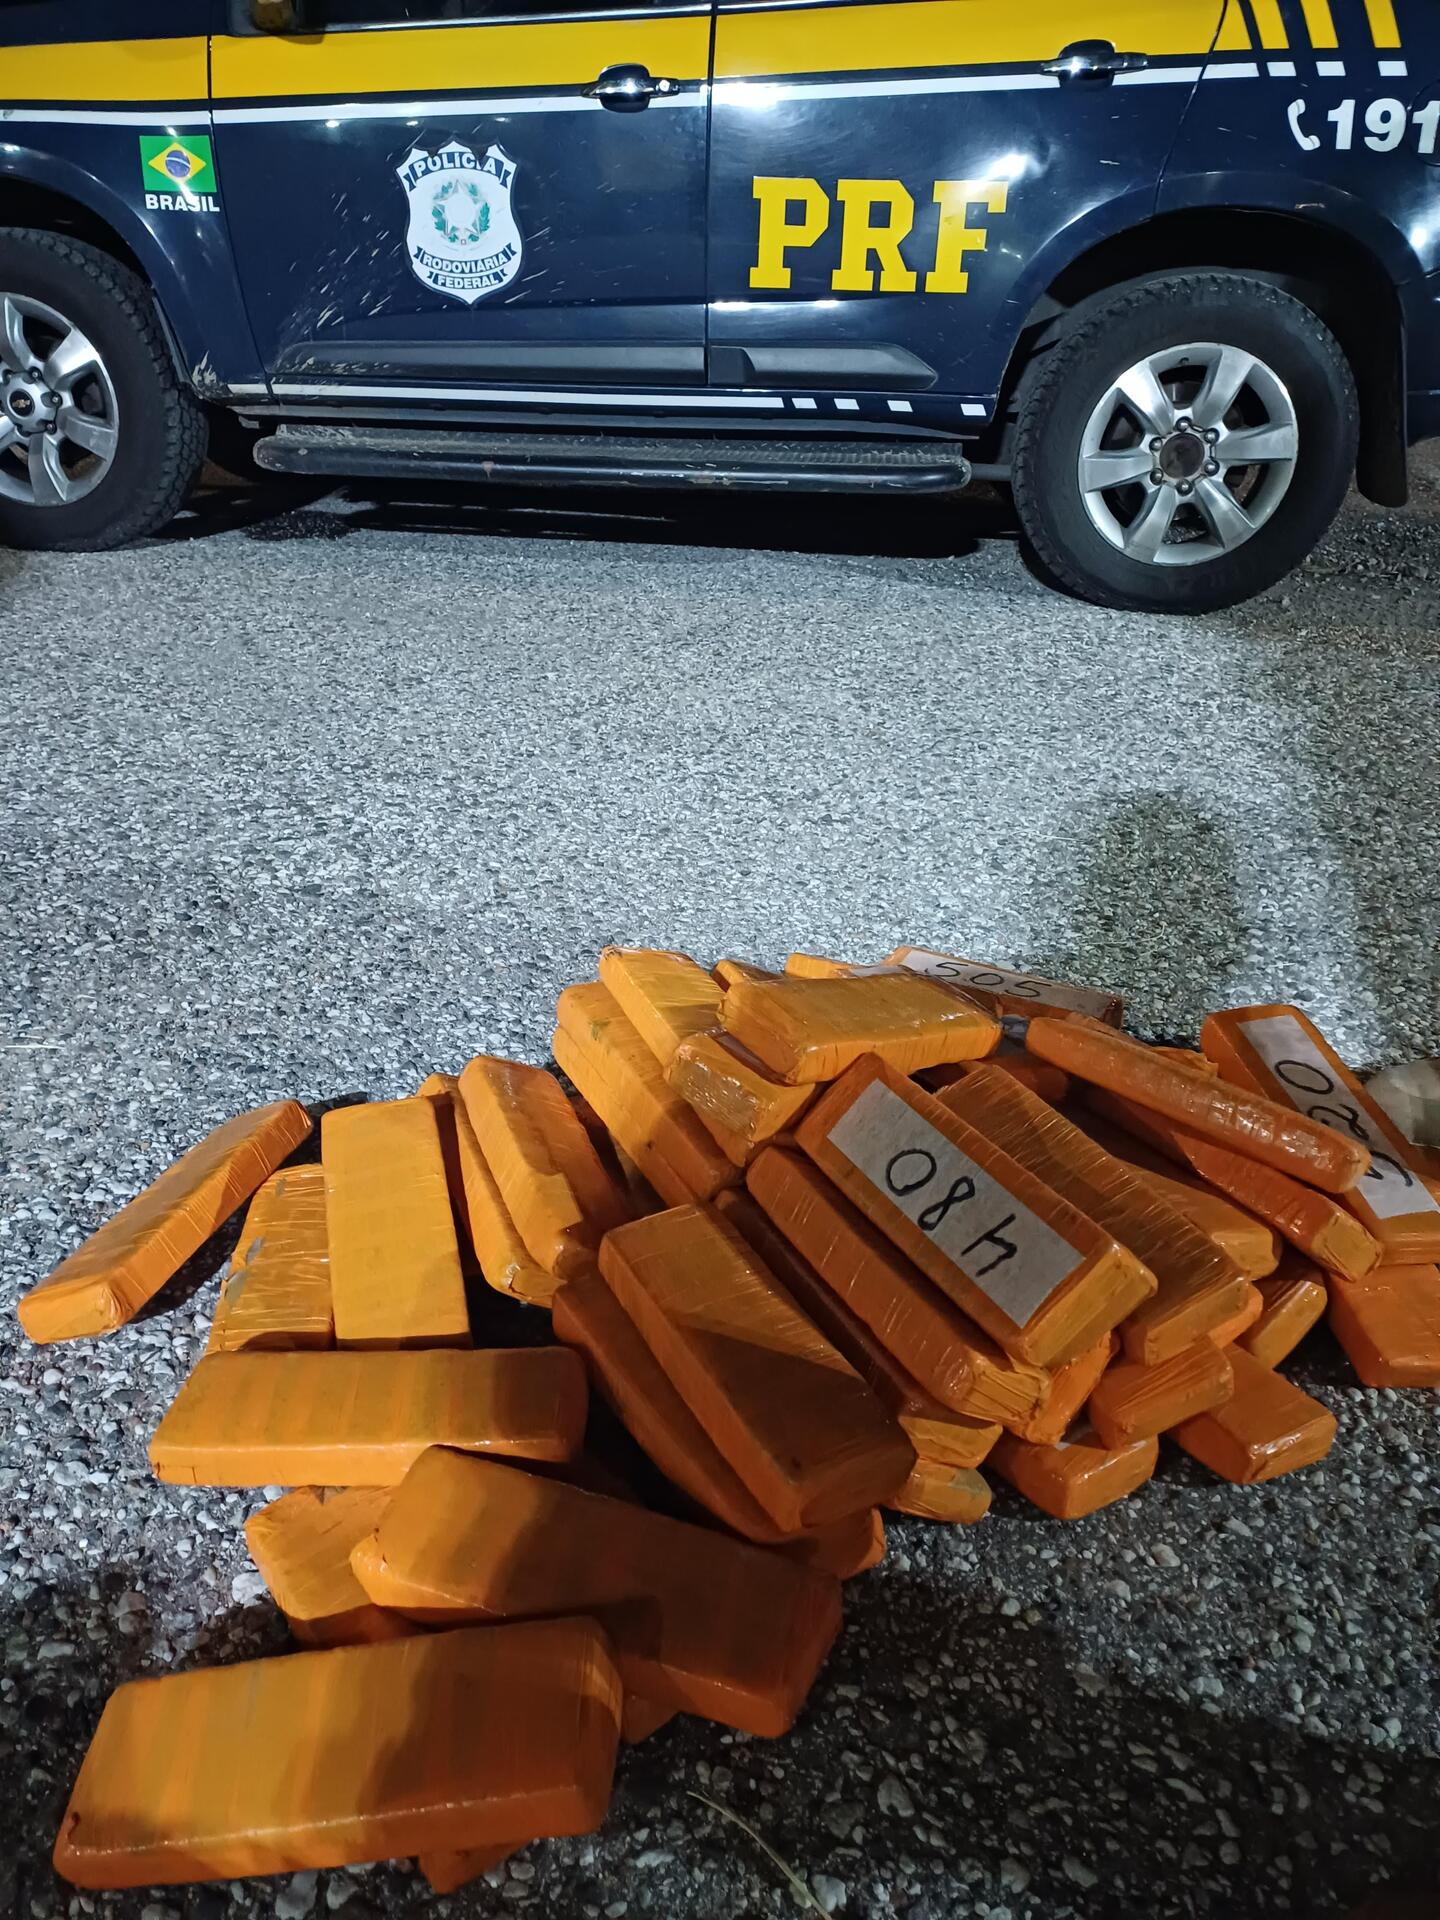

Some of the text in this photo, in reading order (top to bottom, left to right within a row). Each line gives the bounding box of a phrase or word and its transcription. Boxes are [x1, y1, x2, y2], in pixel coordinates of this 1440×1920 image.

[1327, 98, 1440, 154] 191
[145, 194, 220, 212] BRASIL
[749, 176, 1008, 293] PRF
[437, 274, 499, 289] FEDERAL
[886, 1148, 1017, 1277] 480
